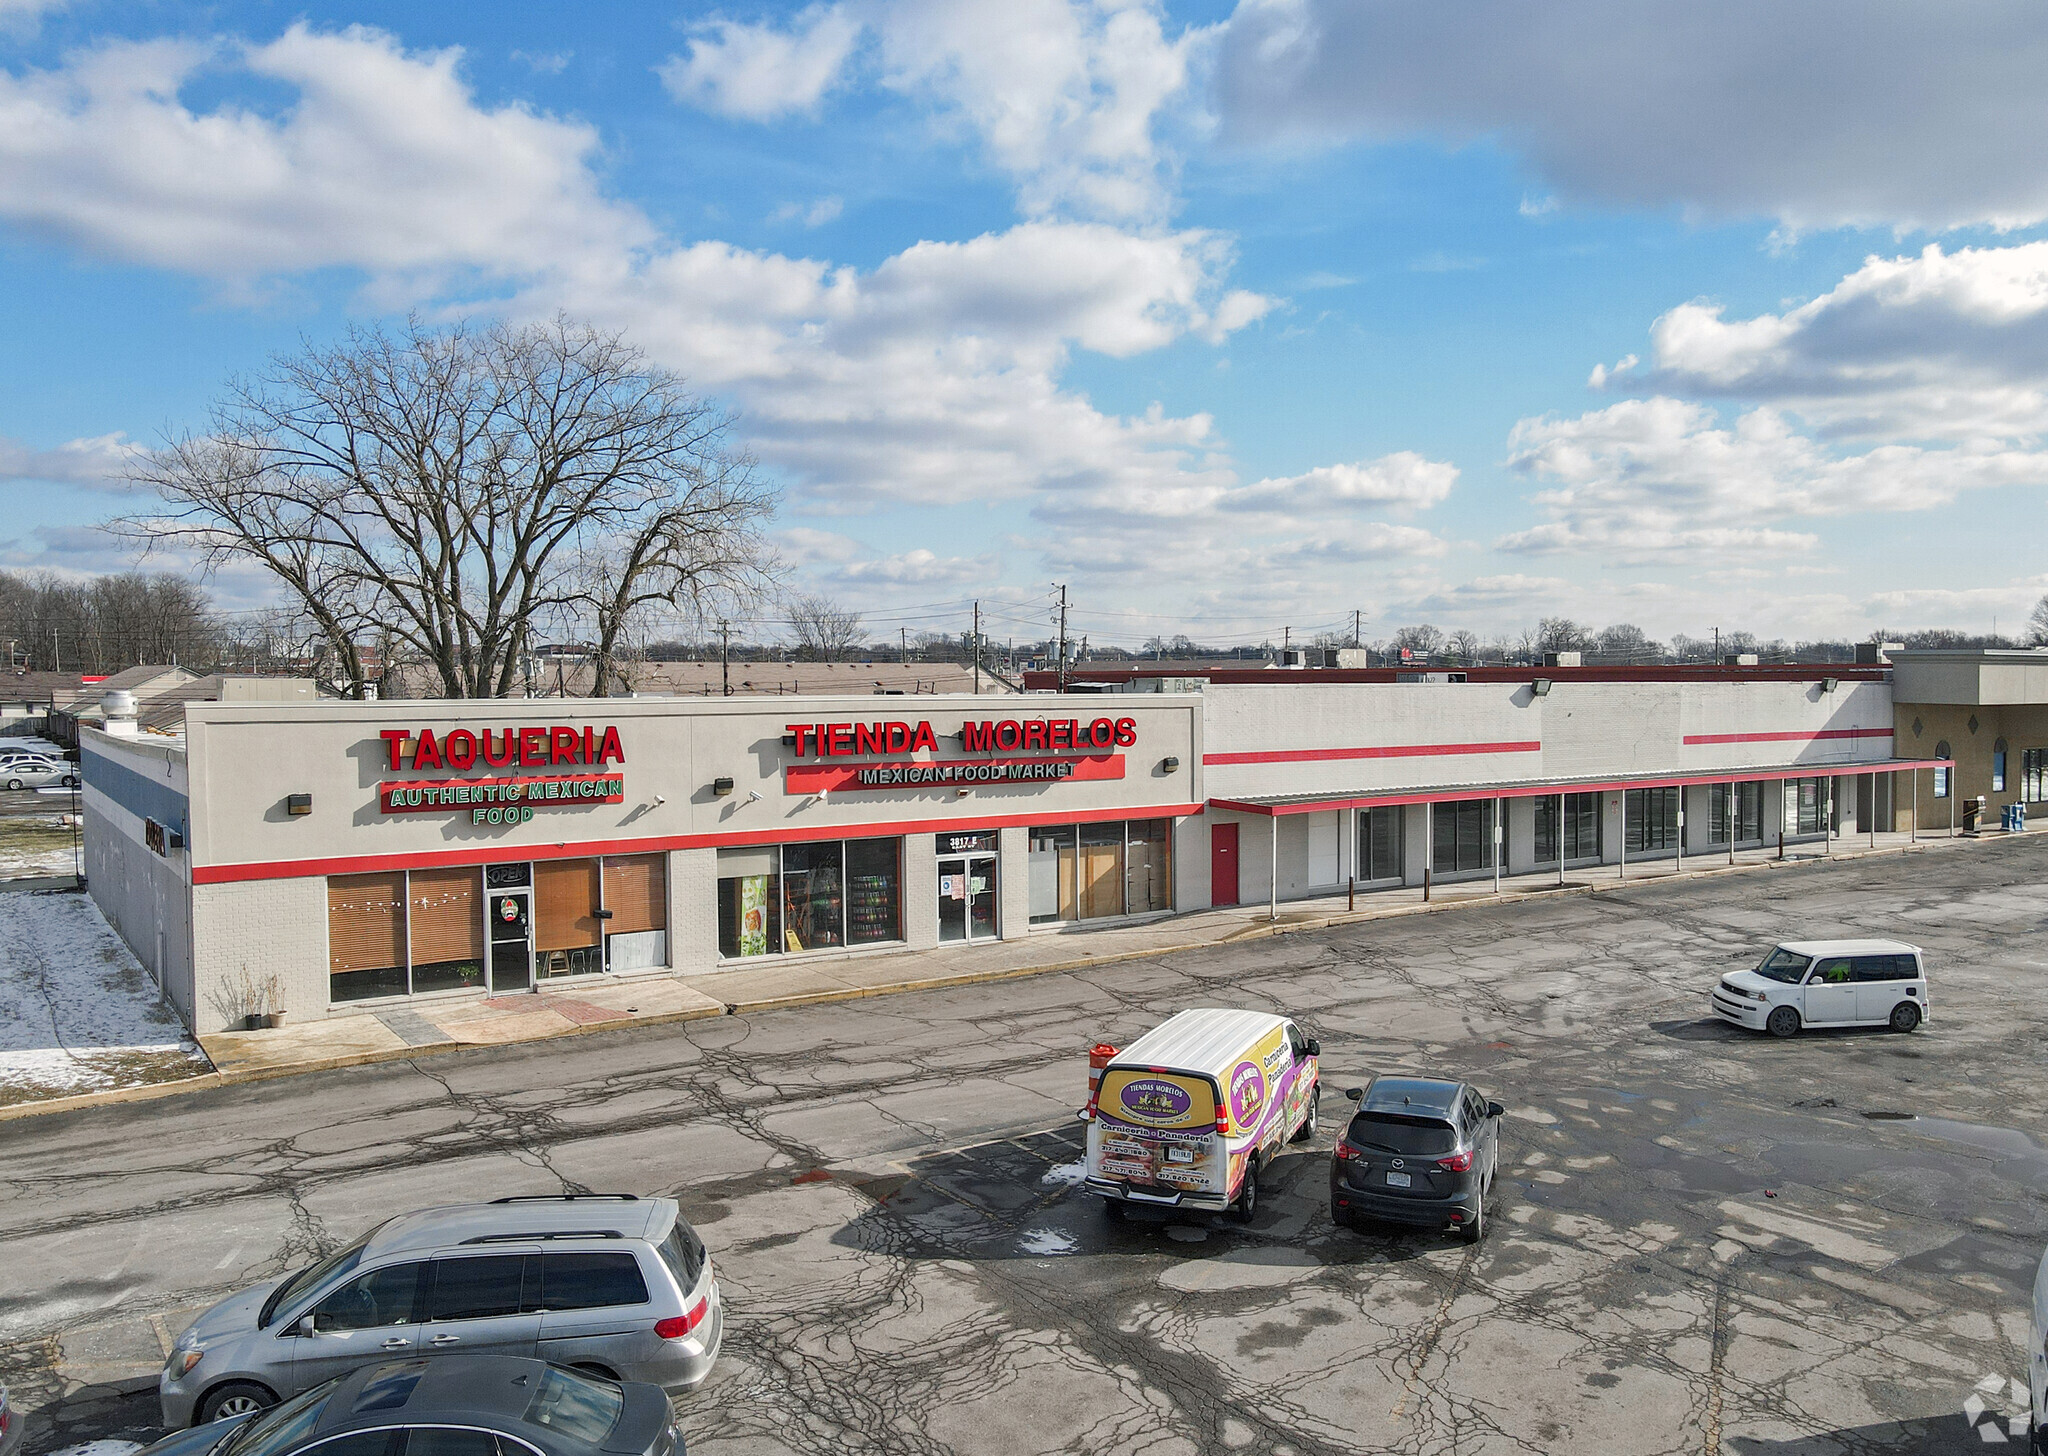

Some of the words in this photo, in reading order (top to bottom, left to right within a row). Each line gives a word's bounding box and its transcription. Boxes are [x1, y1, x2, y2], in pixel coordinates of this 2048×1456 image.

[786, 720, 939, 757] TIENDA
[963, 717, 1137, 751] MORELOS
[380, 726, 625, 770] TAQUERIA
[863, 766, 946, 784] MEXICAN
[954, 764, 1001, 780] FOOD
[1008, 763, 1076, 779] MARKET
[390, 785, 521, 807] AUTHENTIC
[528, 780, 622, 800] MEXICAN
[473, 806, 534, 826] FOOD
[950, 837, 969, 846] 3817
[972, 836, 978, 844] E
[491, 868, 524, 883] OPEN
[1130, 1084, 1154, 1093] TIENDAS
[1155, 1085, 1183, 1098] MORELOS
